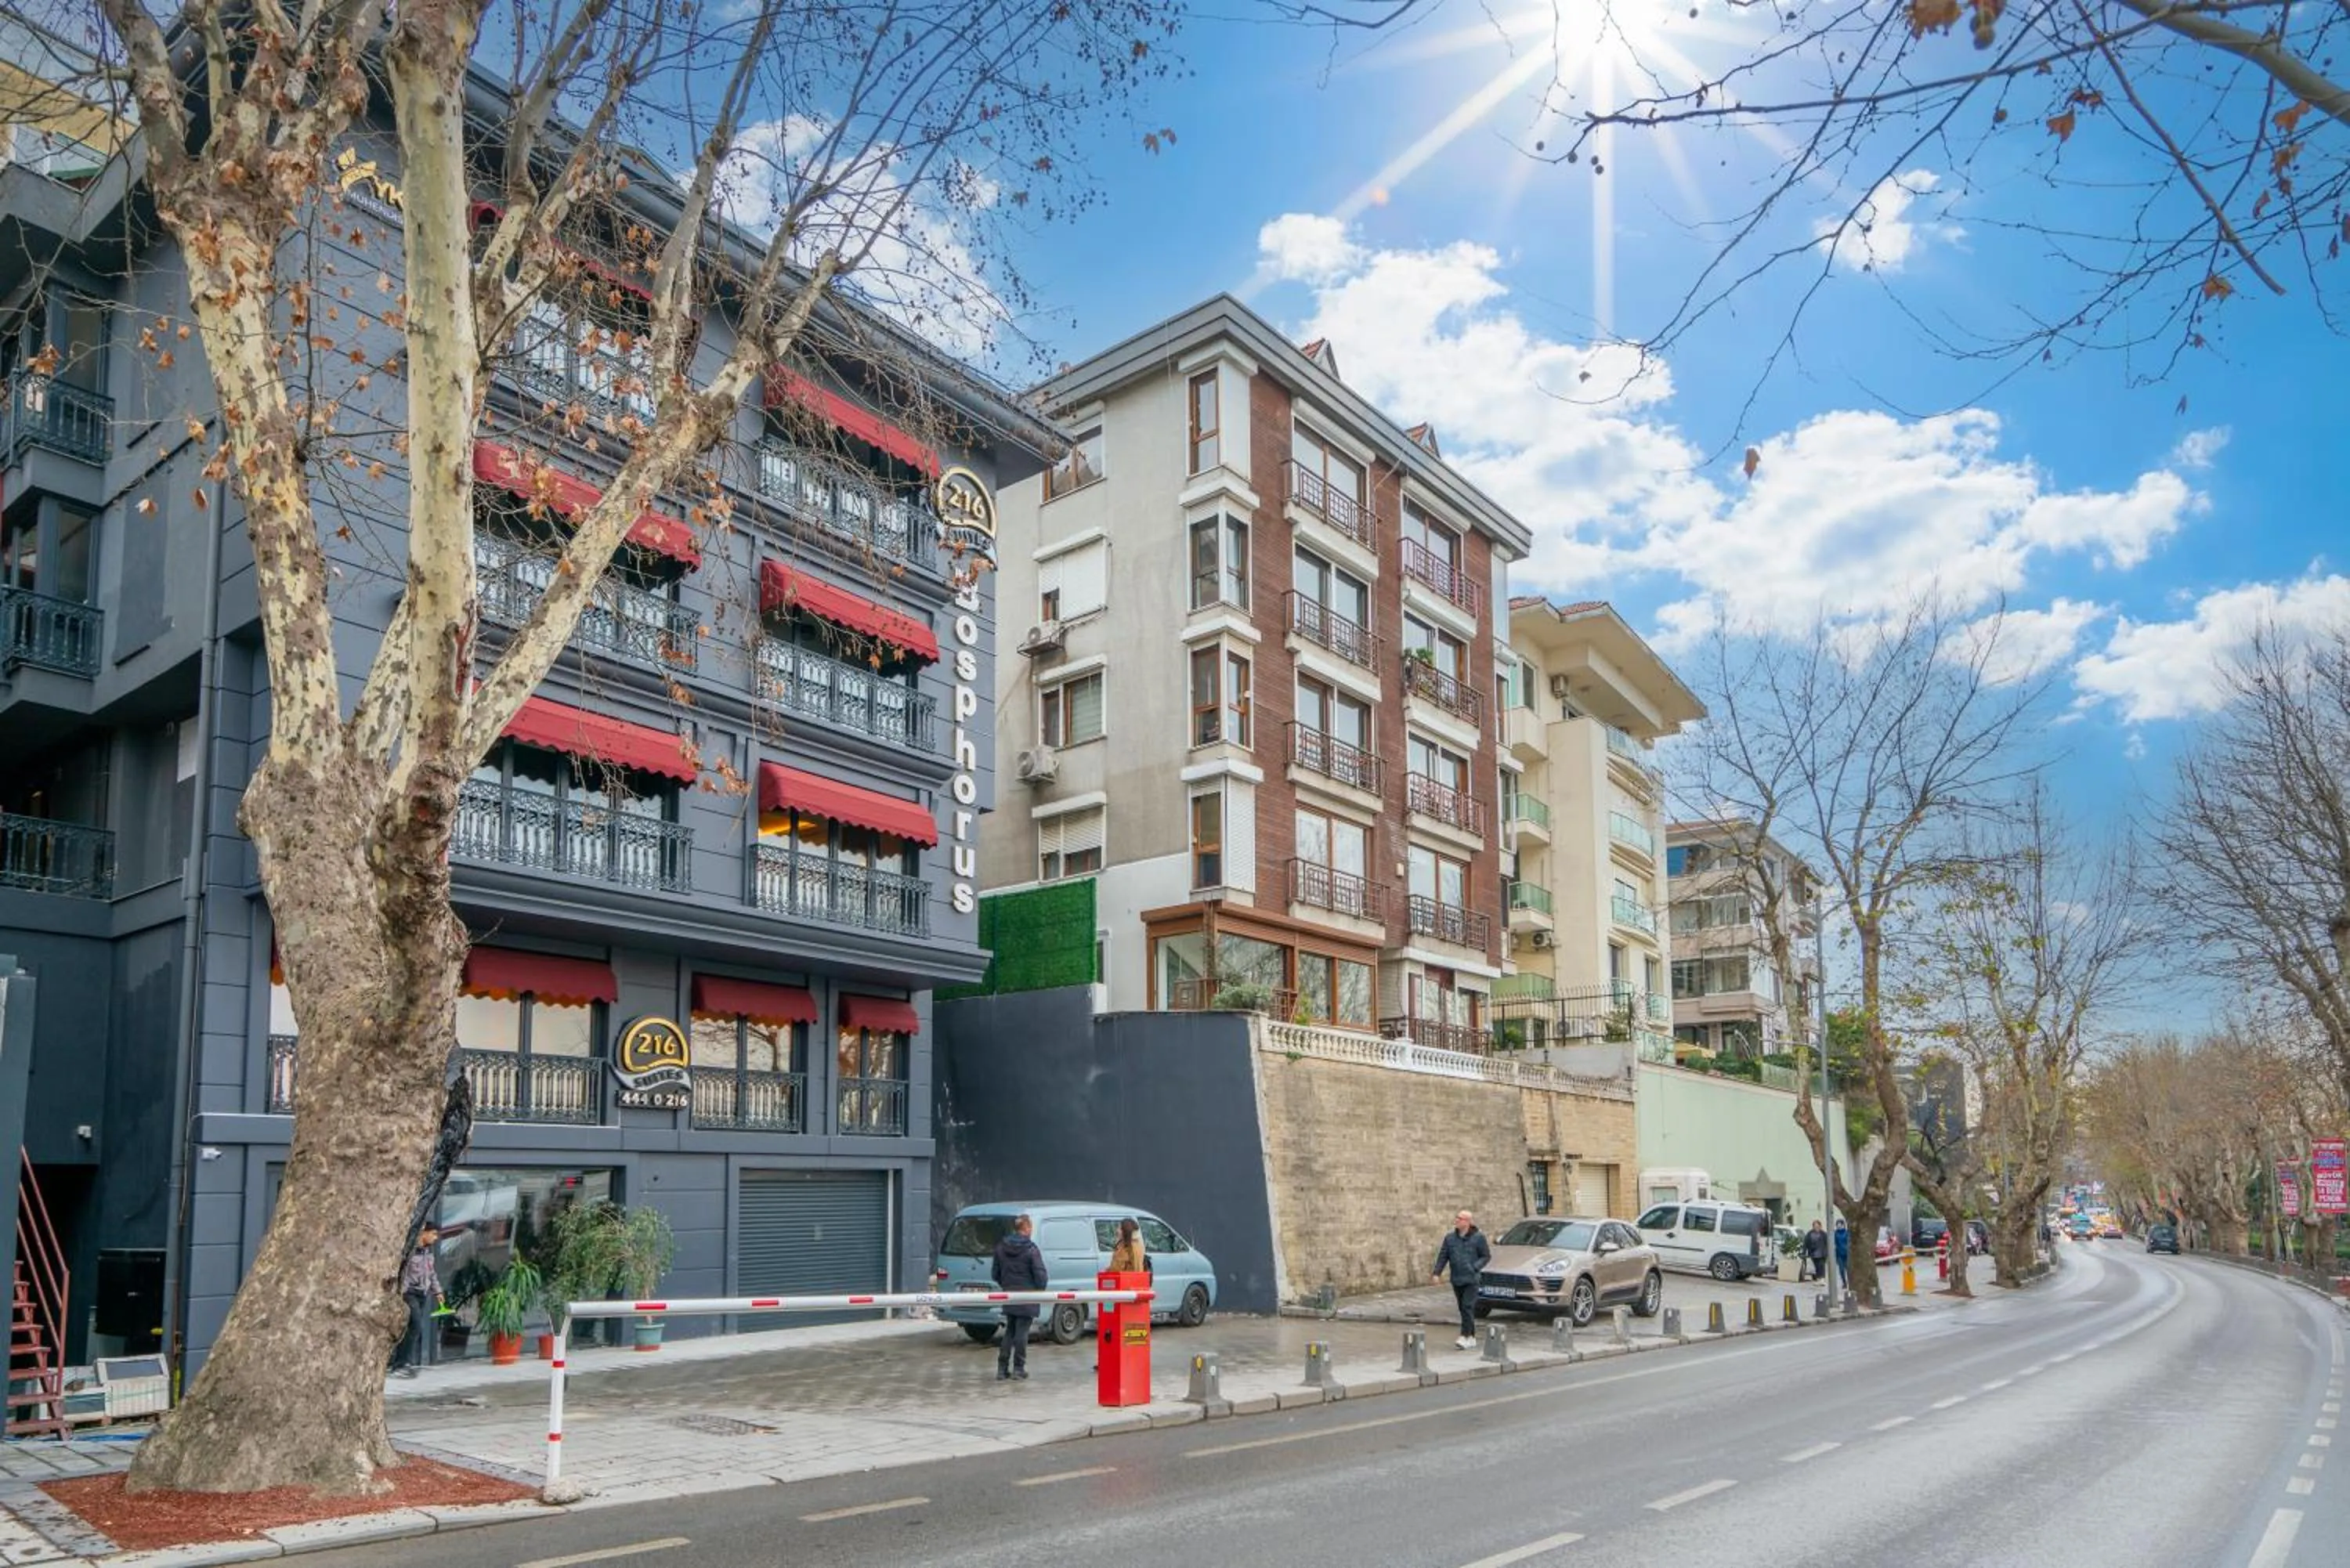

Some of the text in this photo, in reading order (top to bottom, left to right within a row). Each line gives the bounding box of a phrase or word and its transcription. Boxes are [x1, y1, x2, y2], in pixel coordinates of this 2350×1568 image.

[947, 482, 985, 519] 216
[637, 1032, 677, 1055] 216
[633, 1070, 683, 1088] SUITES
[622, 1092, 688, 1107] 444 0 216
